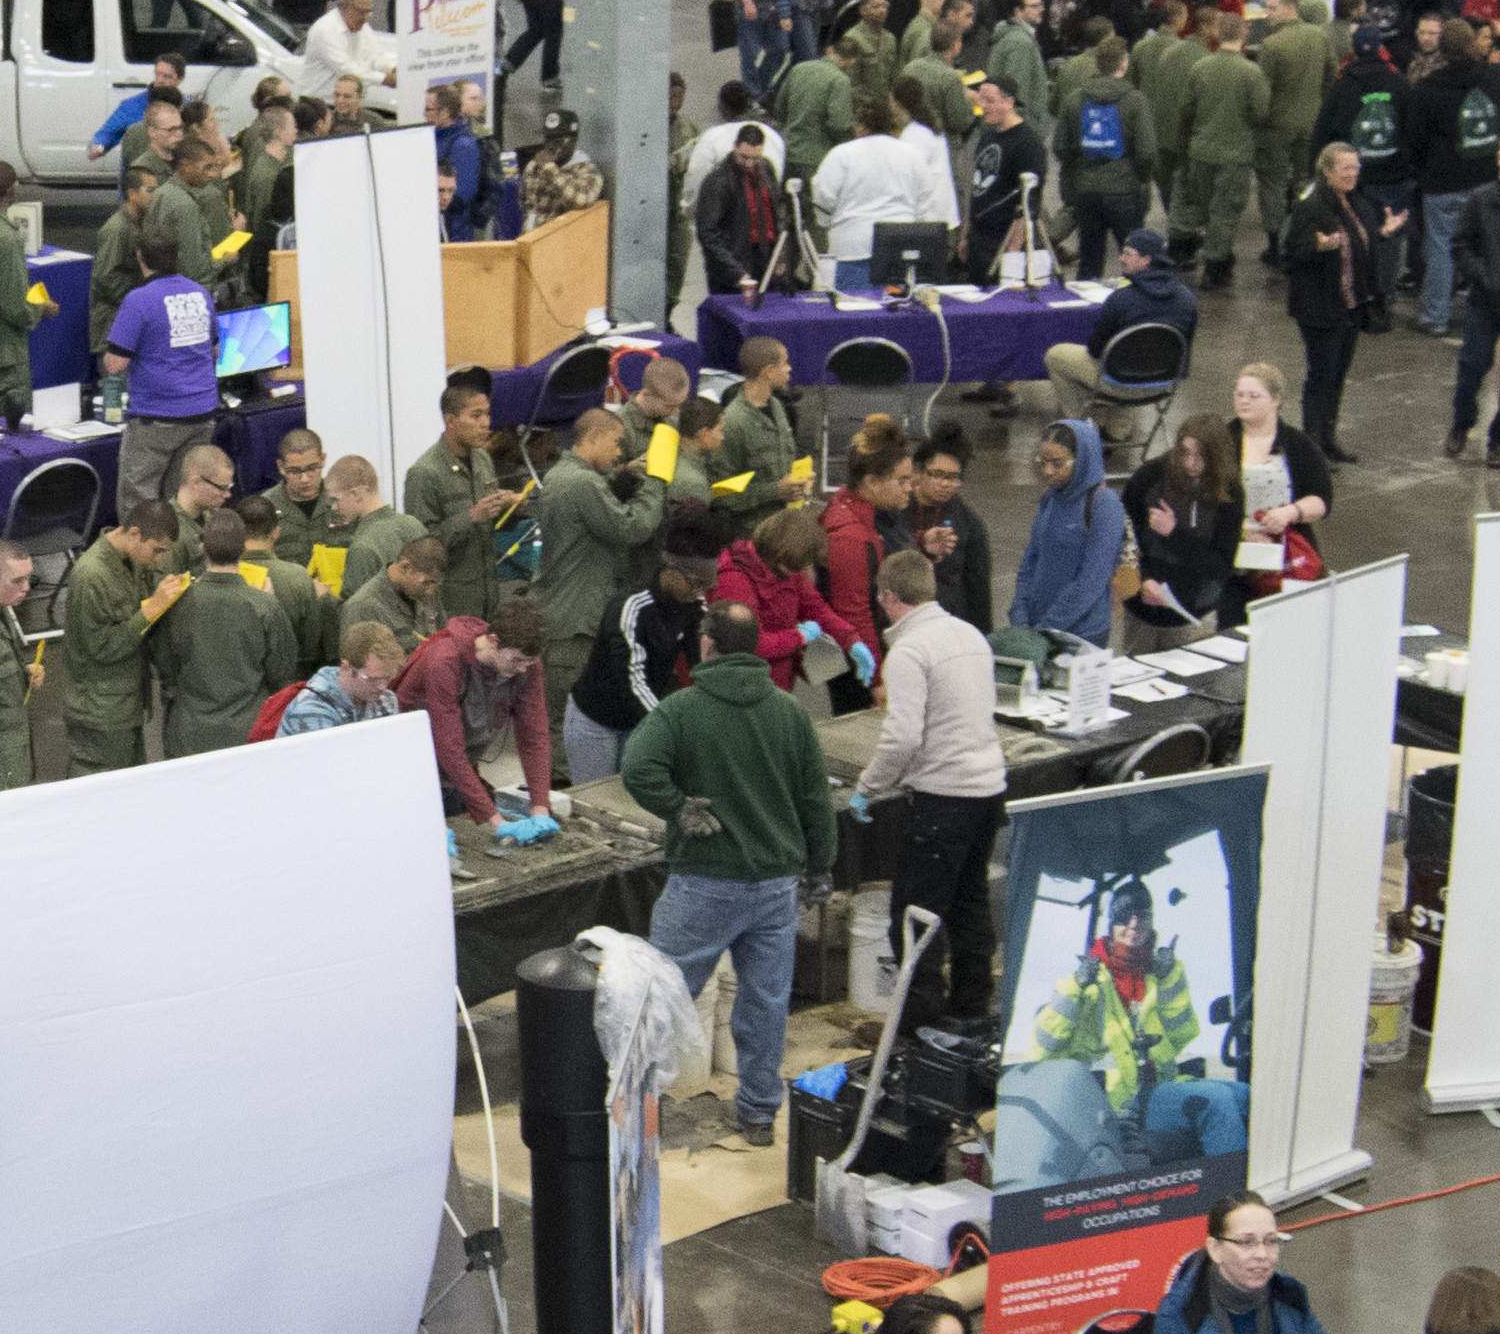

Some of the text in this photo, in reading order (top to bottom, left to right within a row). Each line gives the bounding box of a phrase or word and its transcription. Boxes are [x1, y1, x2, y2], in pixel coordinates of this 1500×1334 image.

[166, 304, 210, 320] PARK
[1410, 904, 1445, 932] ST
[1043, 1168, 1203, 1208] THE EMPLOYMENT CHOICE FOR
[1120, 1184, 1199, 1206] HIGH-DEMAND
[1082, 1205, 1161, 1229] OCCUPATIONS
[1001, 1259, 1141, 1294] OFFERING STATE APPROVED
[1001, 1272, 1129, 1306] APPRENTICESHIP & CRAFT
[1000, 1286, 1119, 1317] TRAINING PROGRAMS IN
